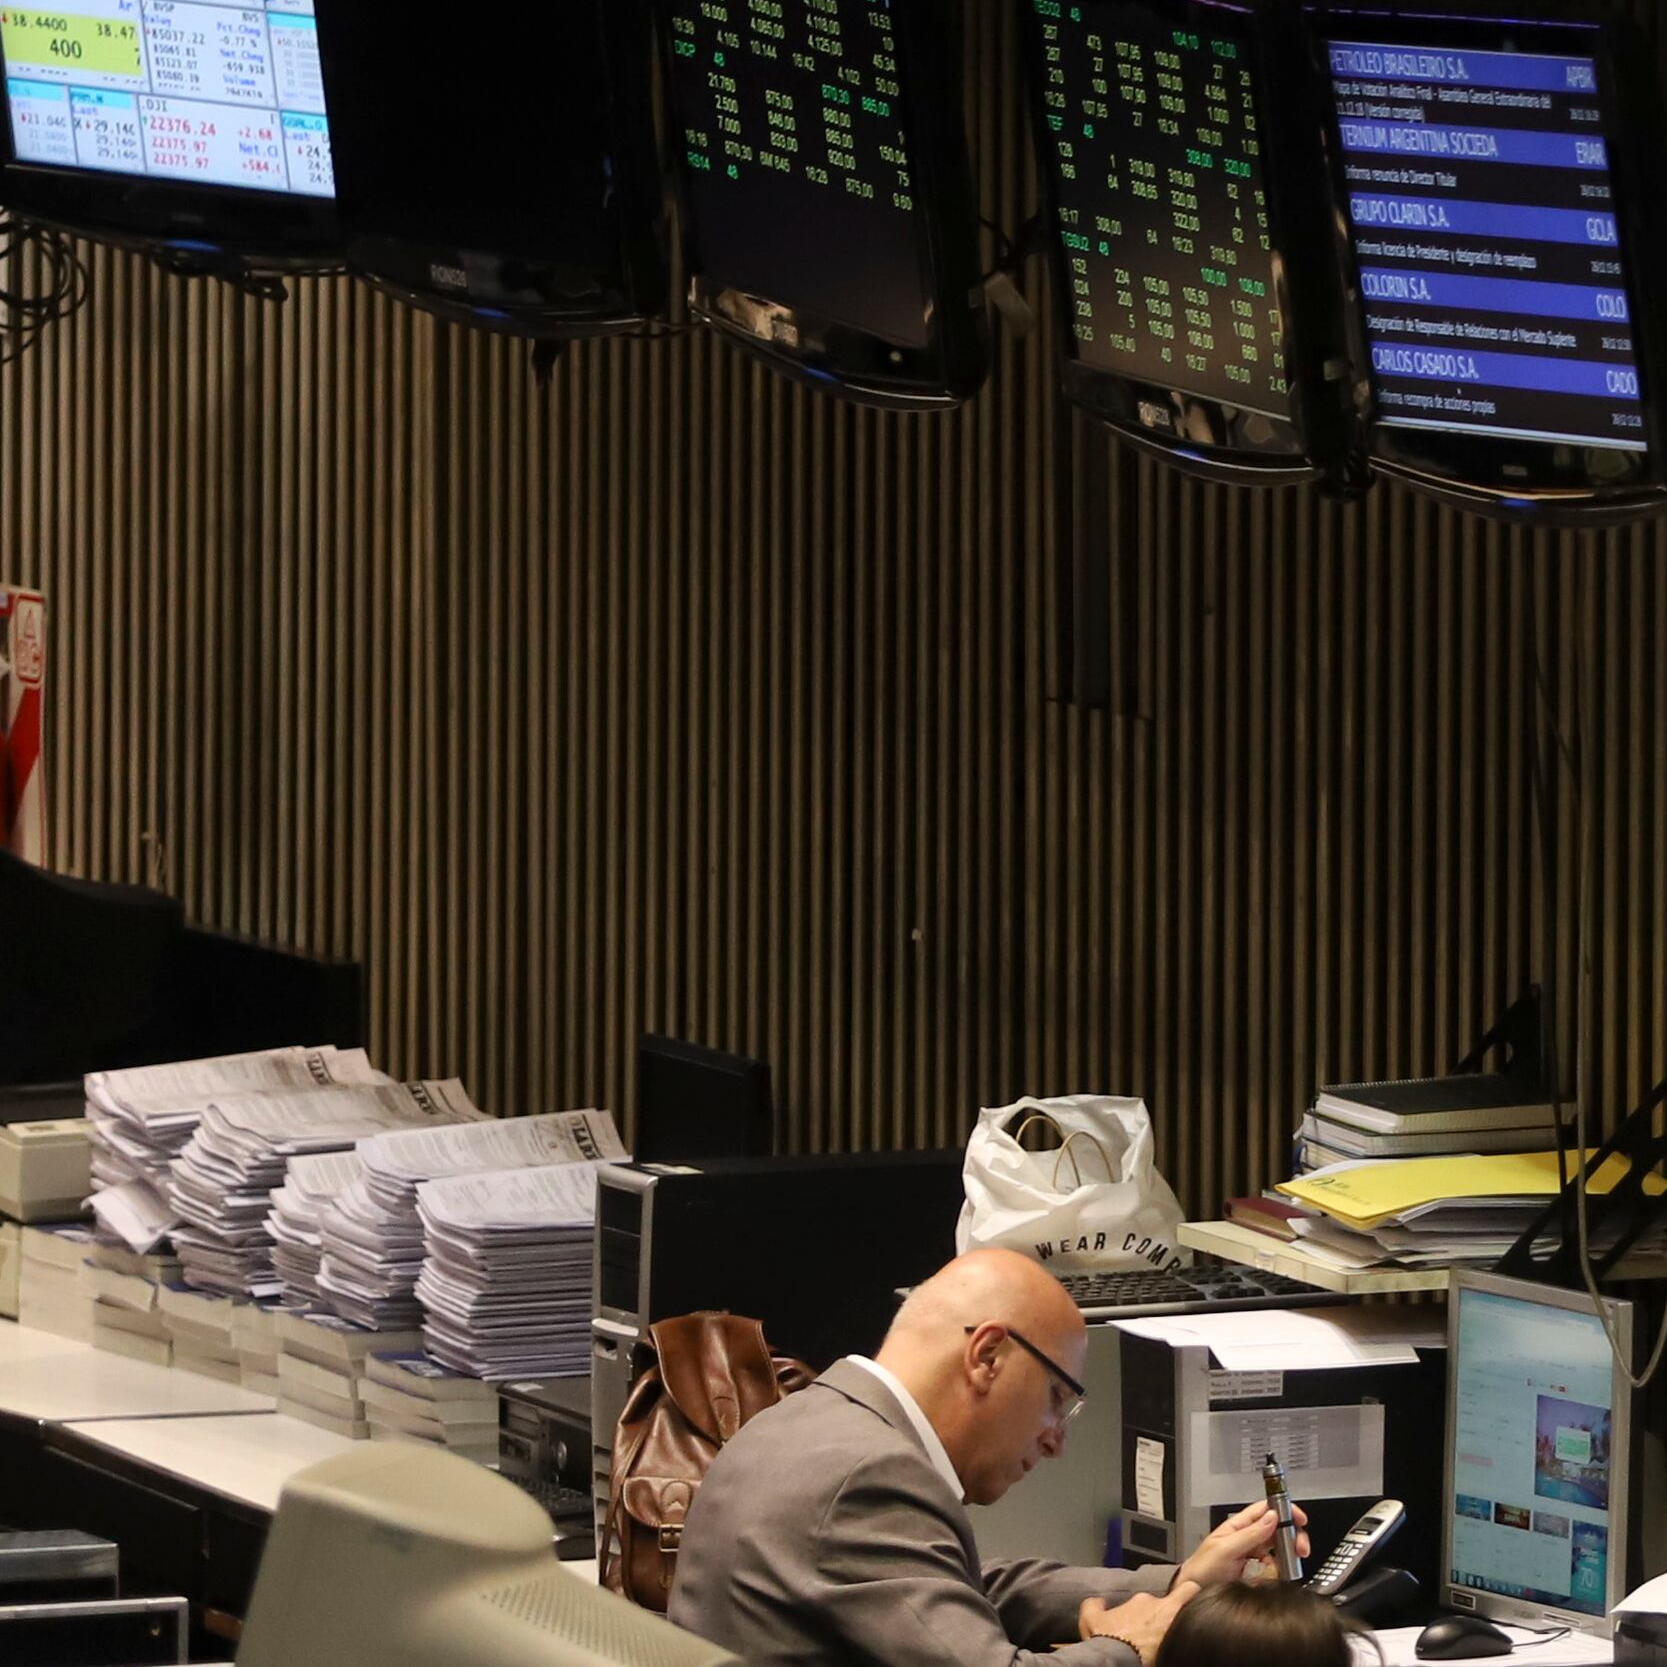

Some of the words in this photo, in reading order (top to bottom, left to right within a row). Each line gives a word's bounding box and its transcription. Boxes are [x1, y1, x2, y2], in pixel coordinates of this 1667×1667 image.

[50, 38, 83, 59] 400
[1350, 198, 1387, 223] GRUPO
[1372, 347, 1413, 373] CARLOS
[1414, 352, 1457, 377] CASADO
[1034, 1231, 1107, 1262] WEAR
